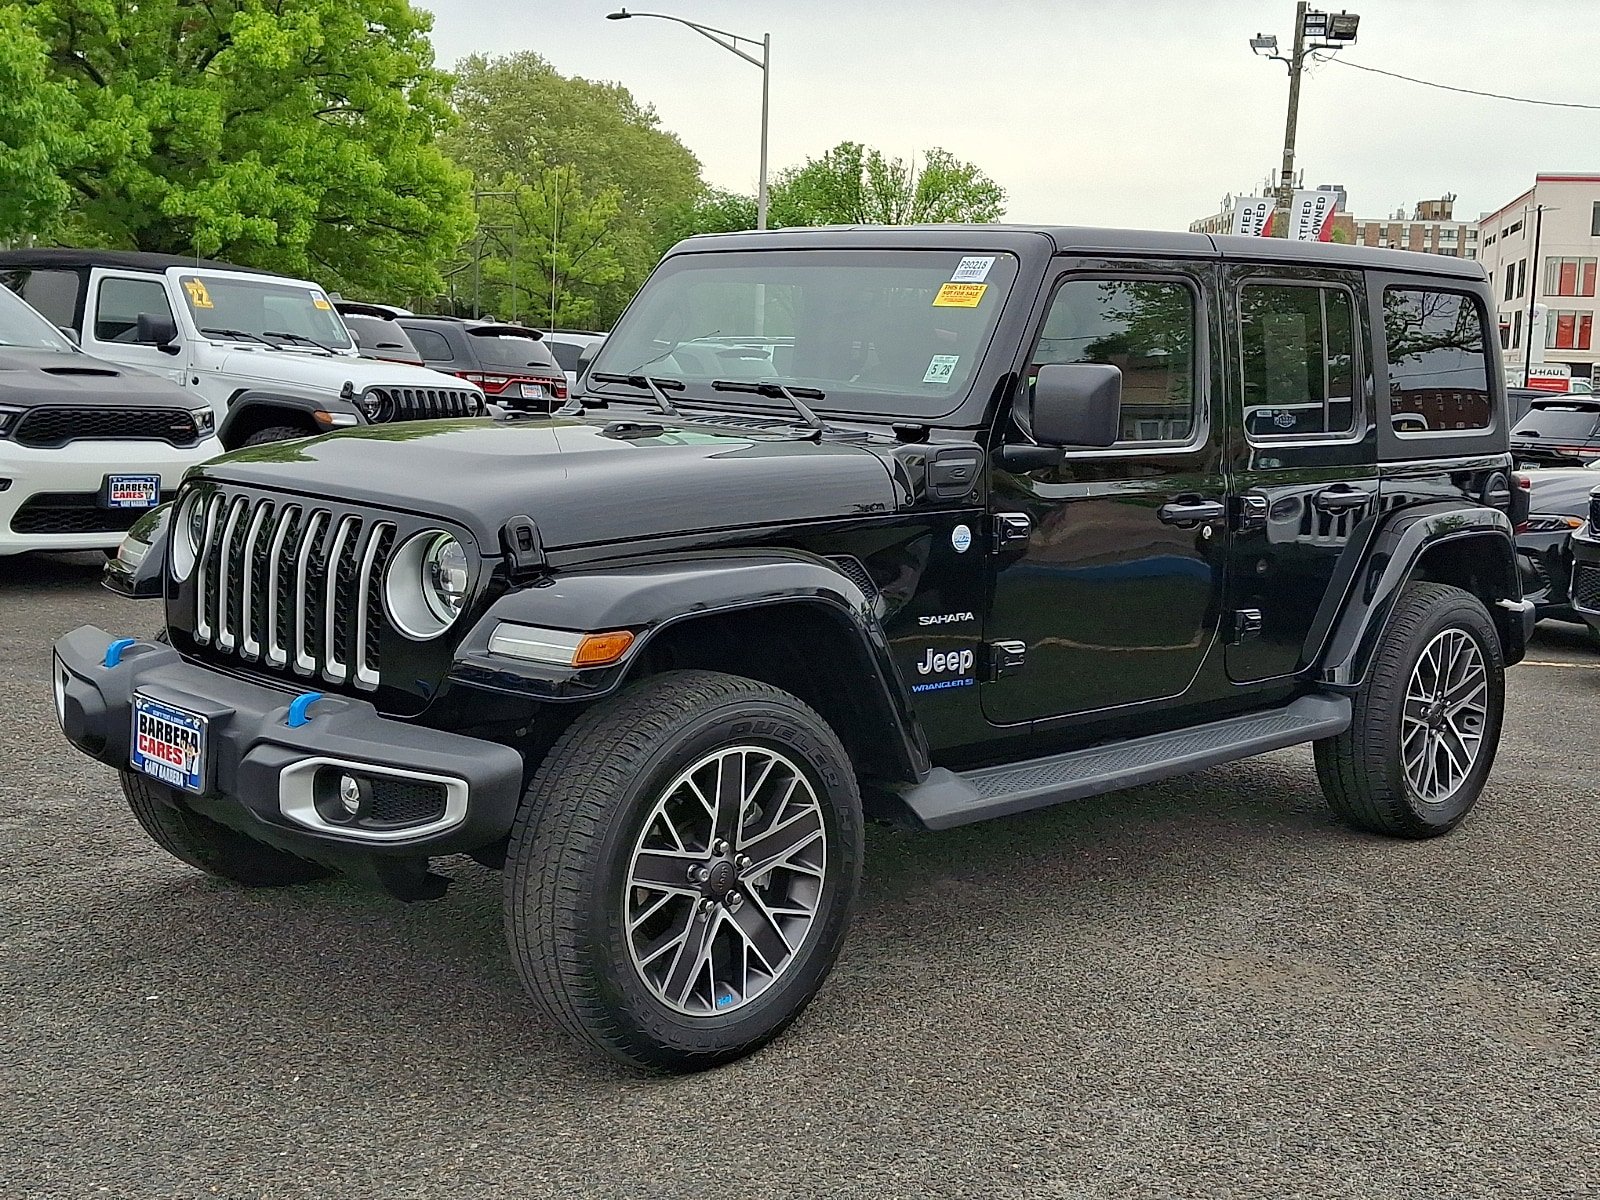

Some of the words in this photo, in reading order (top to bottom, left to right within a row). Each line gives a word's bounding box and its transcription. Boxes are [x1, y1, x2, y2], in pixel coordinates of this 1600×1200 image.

[939, 364, 952, 376] 28
[113, 483, 154, 492] BARBERA
[112, 491, 144, 499] CARES
[917, 611, 975, 626] SAHARA
[916, 647, 975, 676] Jeep
[911, 679, 964, 693] WRANGLER
[139, 712, 199, 754] BARBERA
[139, 734, 183, 766] CARES
